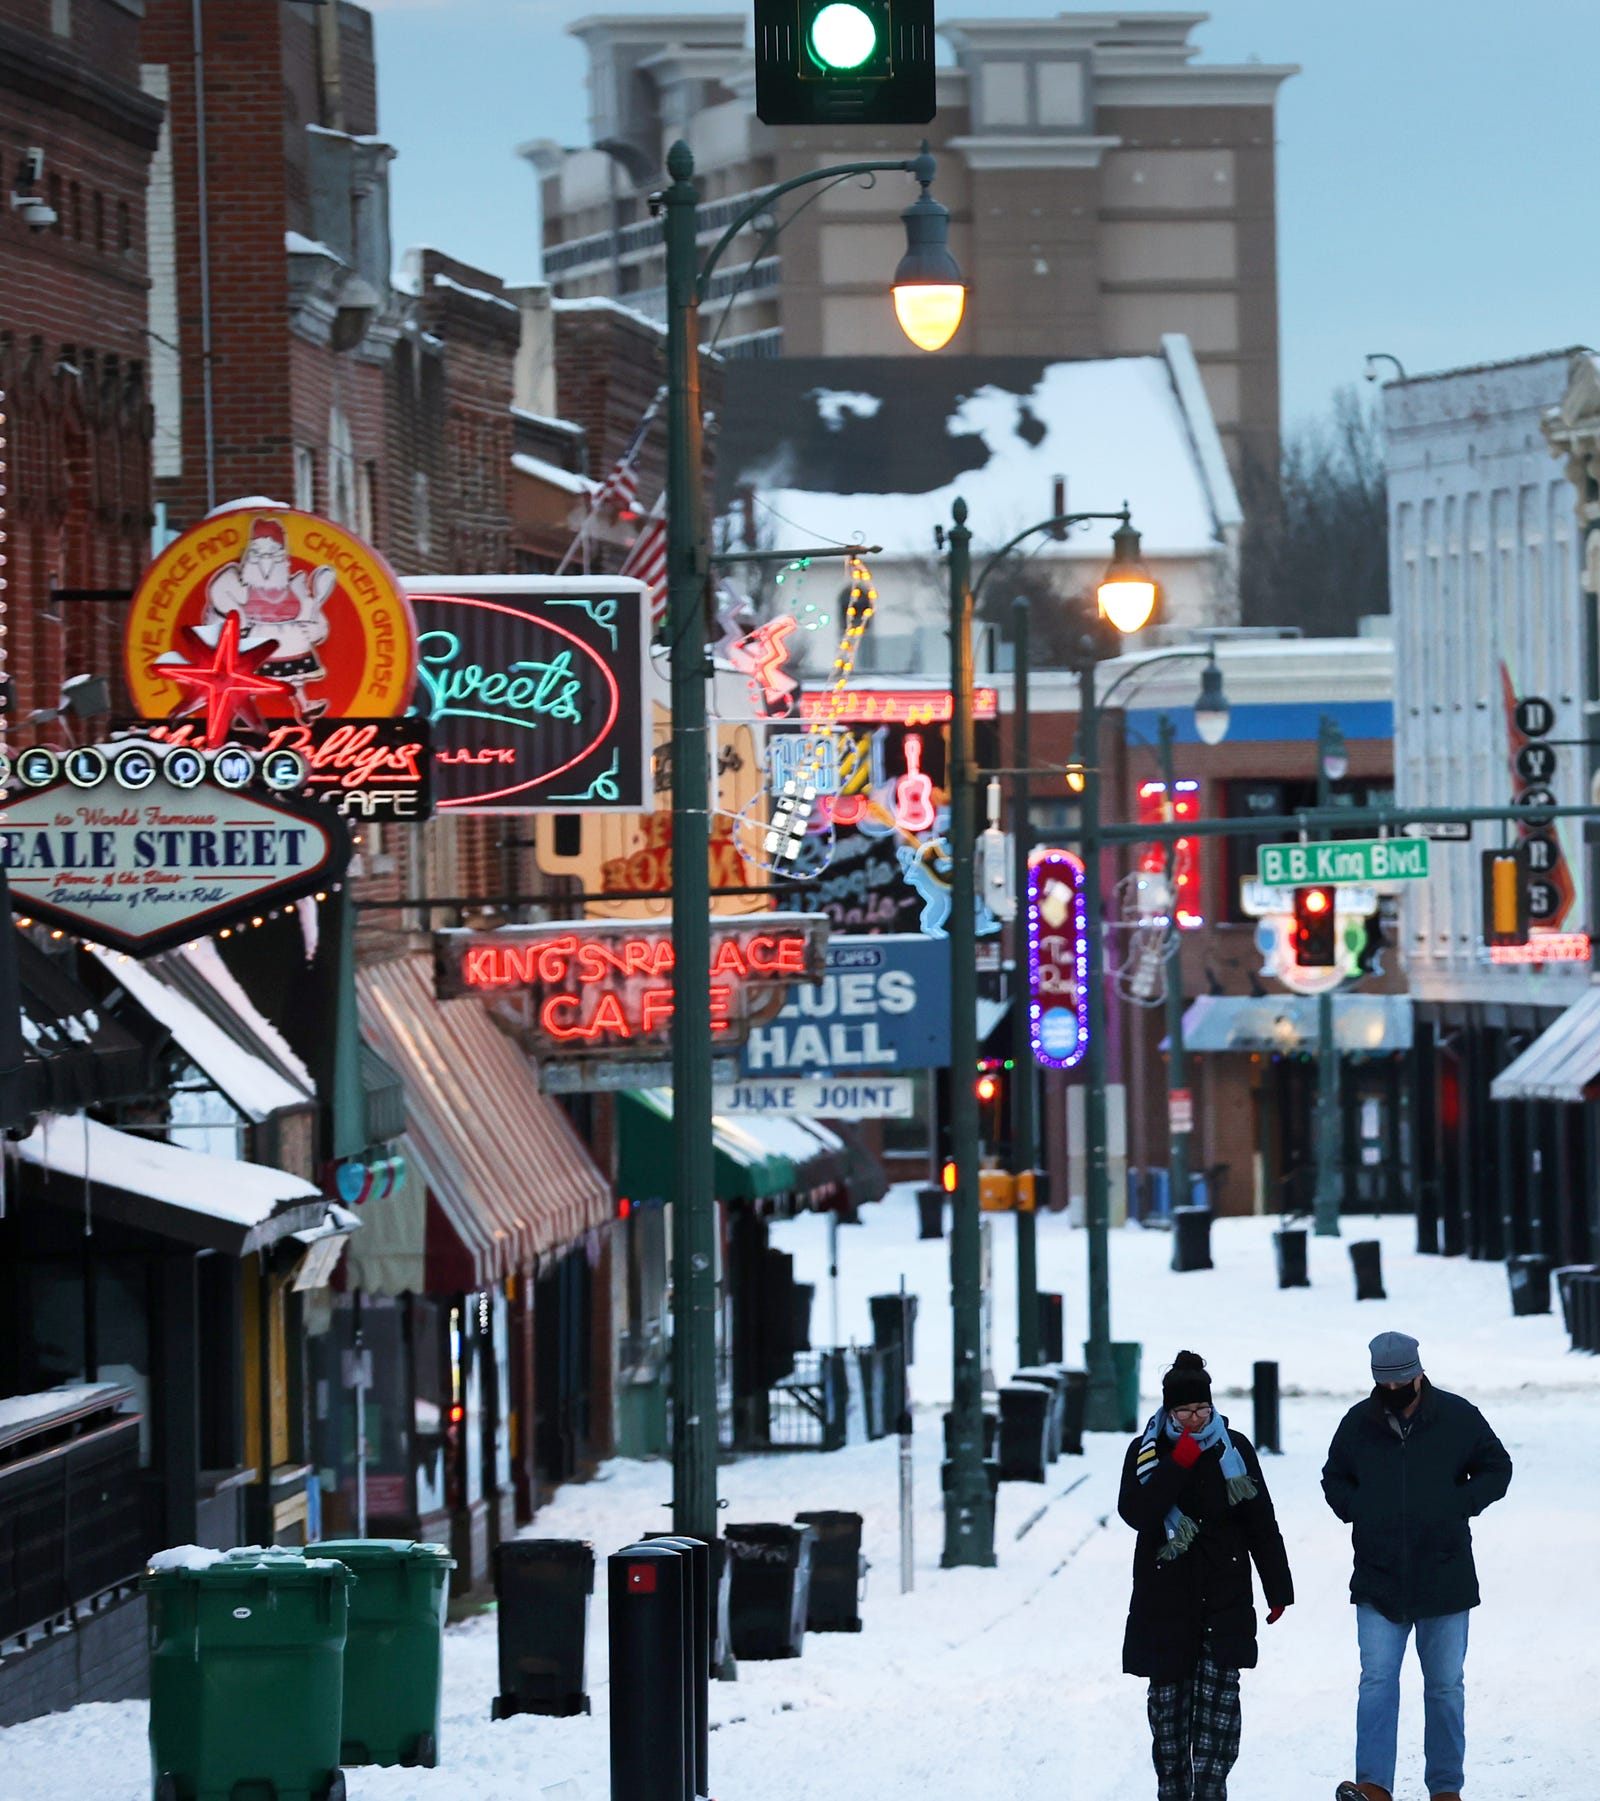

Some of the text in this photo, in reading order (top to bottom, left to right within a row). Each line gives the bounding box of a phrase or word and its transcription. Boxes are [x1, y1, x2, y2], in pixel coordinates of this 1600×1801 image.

[147, 551, 198, 623] PEACE
[197, 527, 240, 562] AND
[303, 531, 380, 604] CHICKEN
[367, 608, 396, 699] GREASE
[0, 751, 301, 786] ELCOME
[54, 806, 218, 826] to World Famous
[0, 828, 306, 869] EALE STREET
[1265, 844, 1427, 882] B.B. King Blvd.
[622, 936, 806, 976] PAACE
[784, 970, 918, 1020] LUES
[748, 1022, 897, 1069] HALL
[728, 1083, 895, 1109] JUKE JOINT
